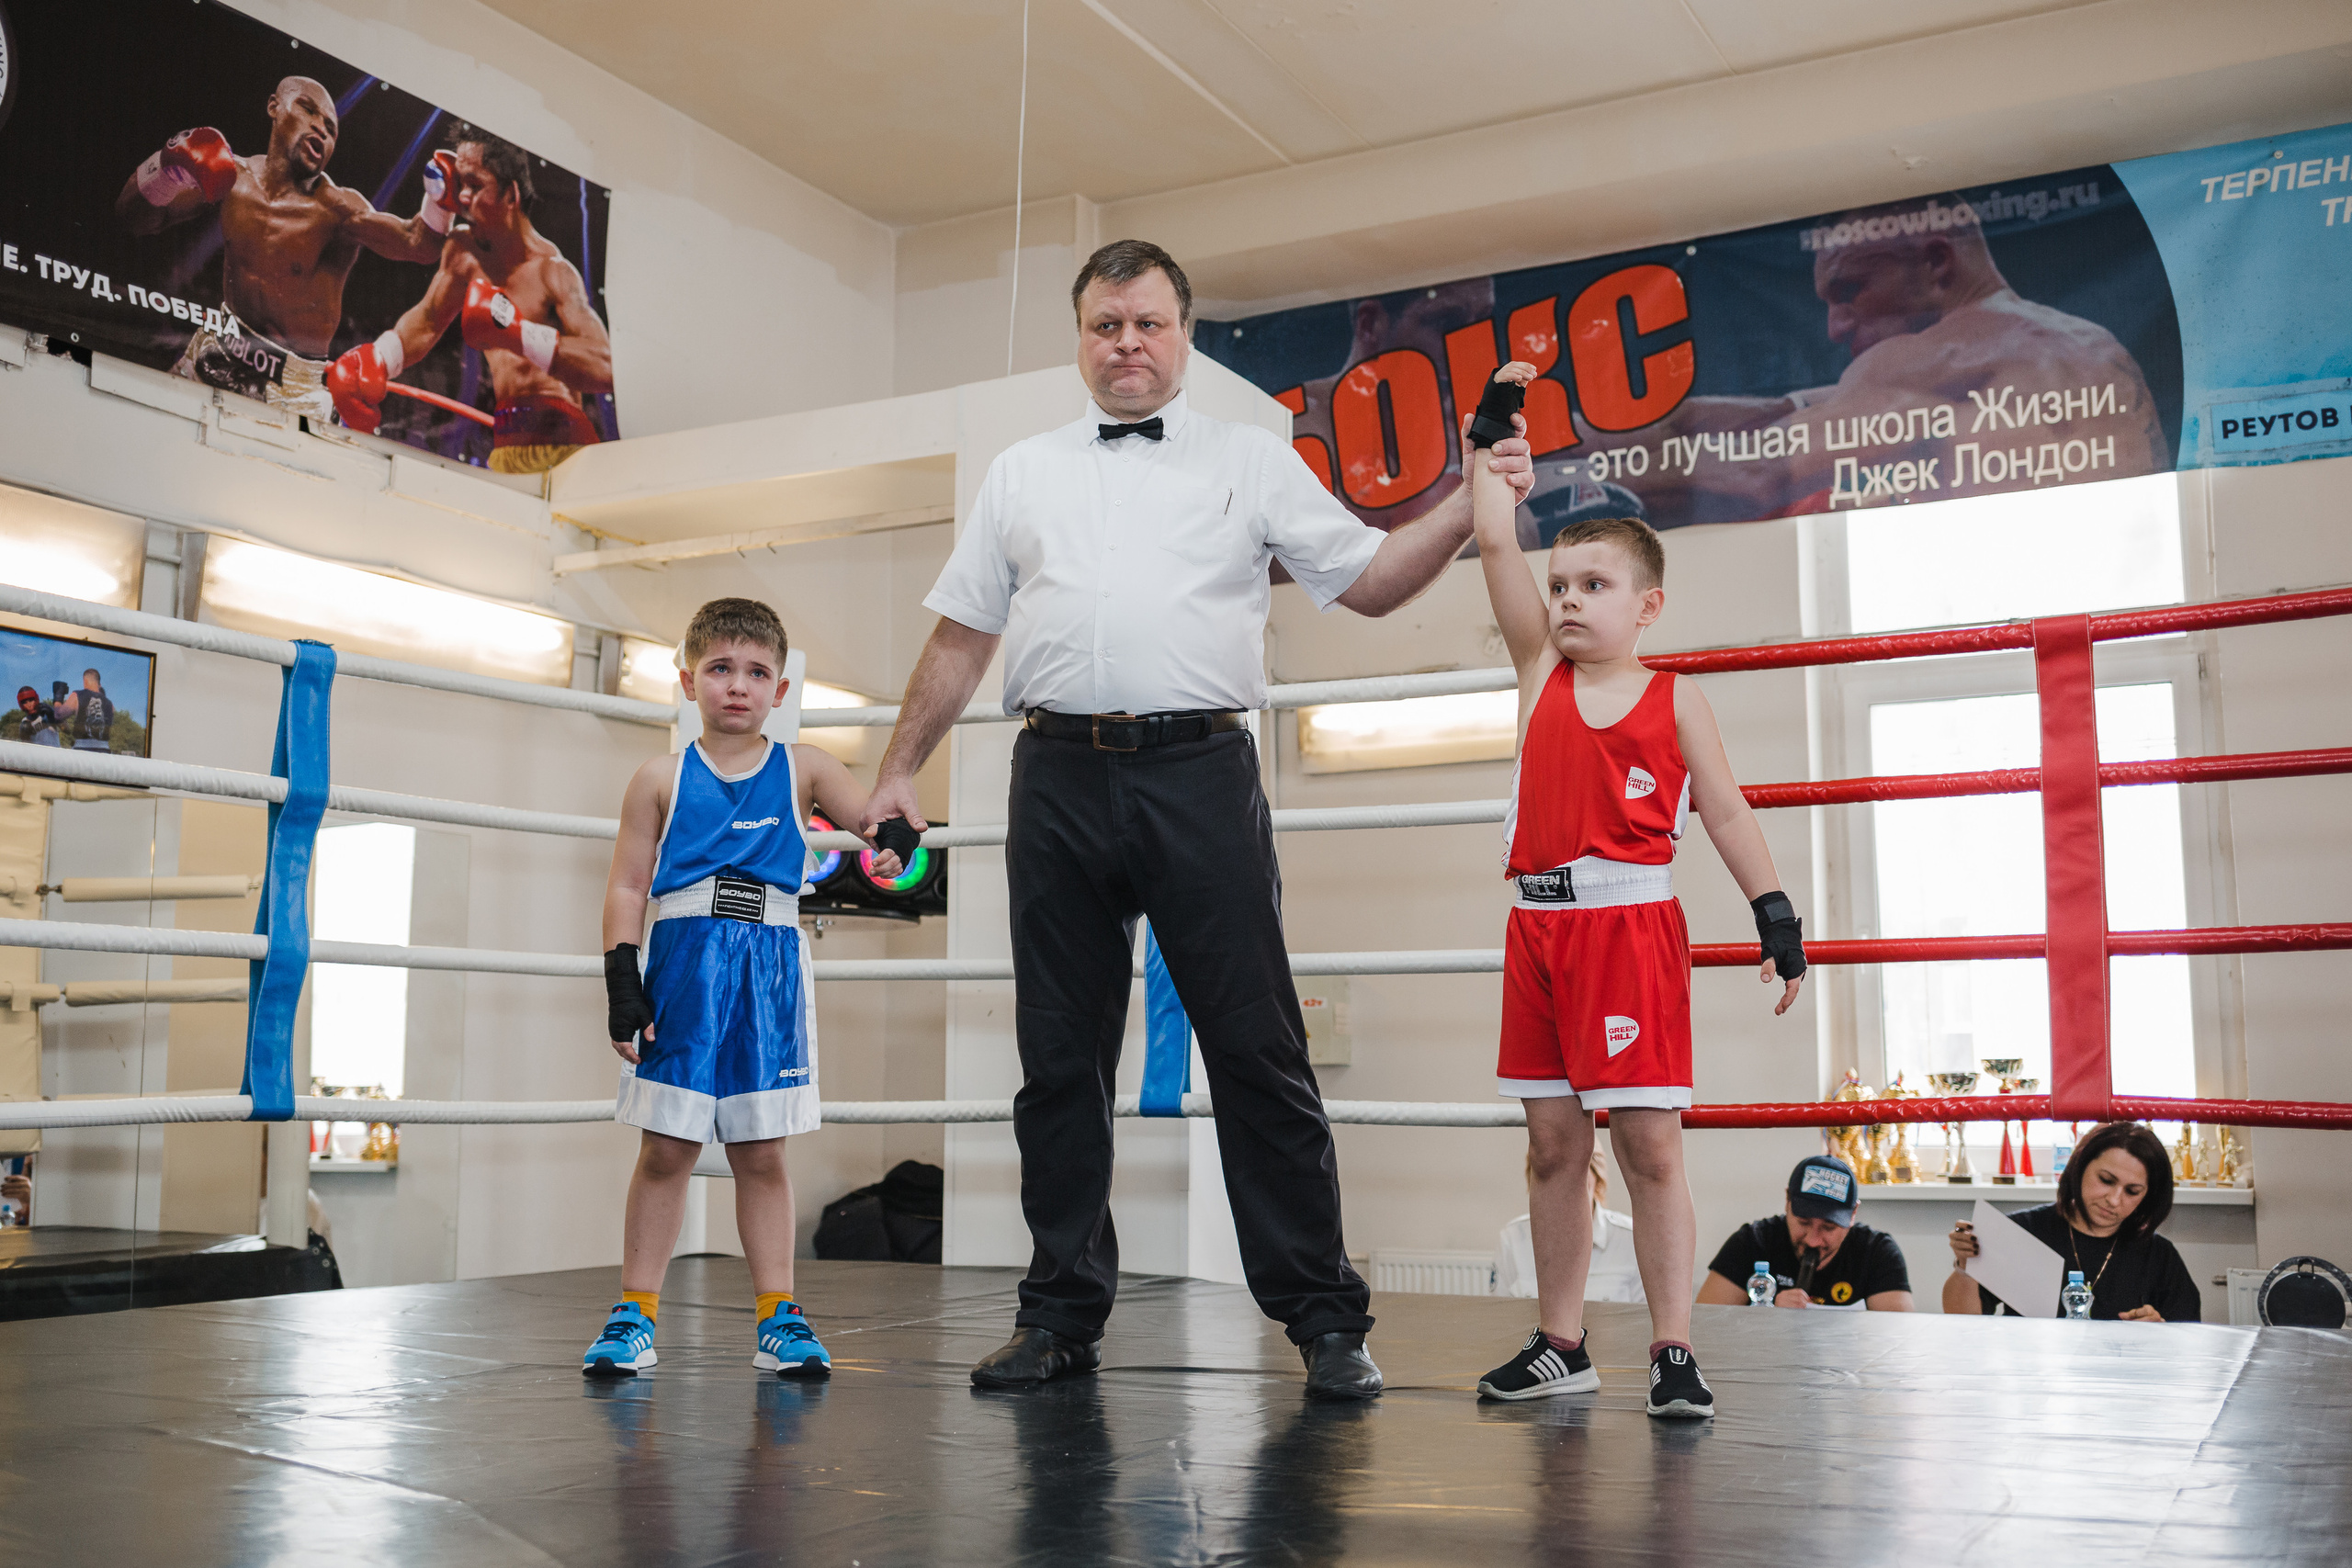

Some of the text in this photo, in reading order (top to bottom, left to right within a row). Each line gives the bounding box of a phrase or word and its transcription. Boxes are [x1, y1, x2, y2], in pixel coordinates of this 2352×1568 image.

[2200, 154, 2352, 203] ТЕРПЕН
[1799, 182, 2100, 252] moscowboxing.ru
[35, 254, 122, 302] ТРУД.
[128, 283, 241, 340] ПОБЕДА
[2222, 407, 2339, 439] РЕУТОВ
[1588, 445, 1650, 483] это
[1659, 422, 1811, 477] лучшая
[1825, 403, 1957, 452] школа
[1967, 382, 2127, 434] Жизни.
[1829, 434, 2115, 511] Джек Лондон
[1627, 781, 1649, 793] HILL
[1628, 776, 1655, 787] GREEN
[731, 817, 779, 829] BOYBO
[1521, 874, 1560, 886] GREEN
[719, 888, 761, 900] BOYBO
[1608, 1025, 1636, 1034] GREEN
[1610, 1032, 1633, 1042] HILL
